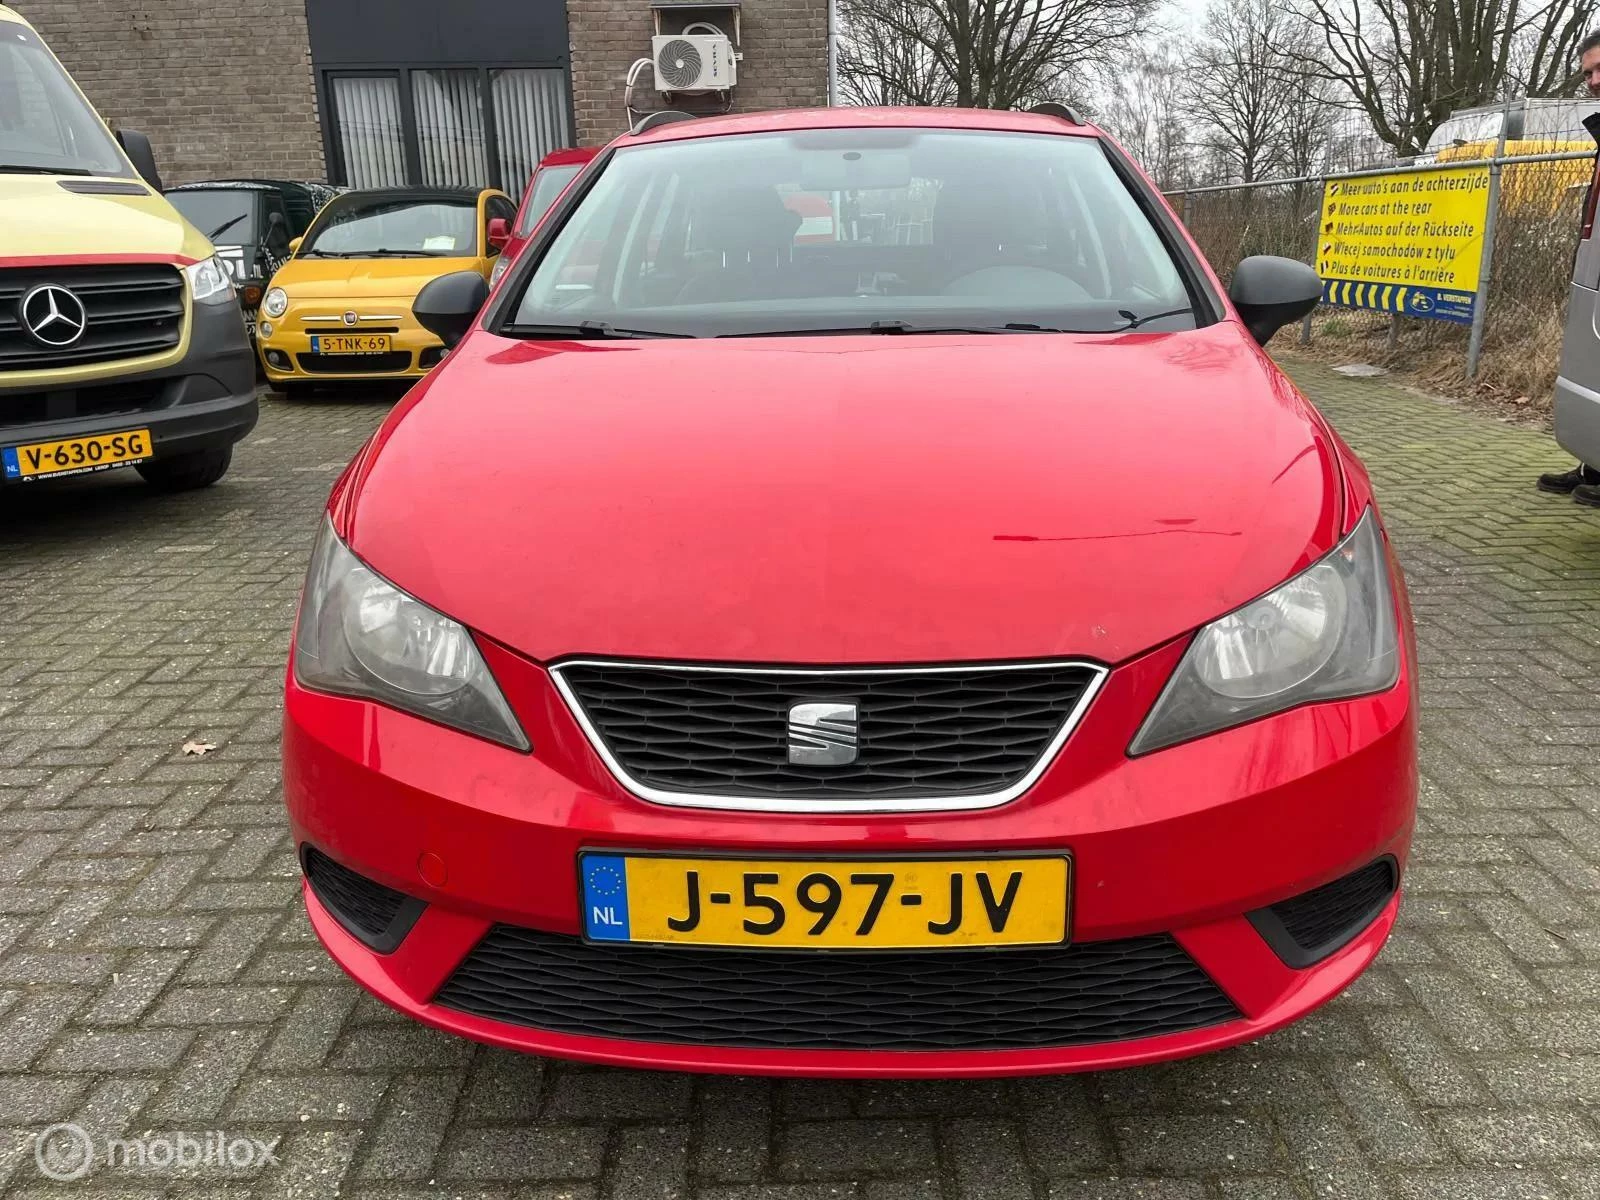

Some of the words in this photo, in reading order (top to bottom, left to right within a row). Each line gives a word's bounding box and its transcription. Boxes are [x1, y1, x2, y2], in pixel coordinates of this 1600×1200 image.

[1341, 182, 1361, 196] Meer
[1363, 180, 1388, 195] auto's
[1390, 180, 1409, 194] aan
[1412, 176, 1424, 192] de
[1426, 172, 1488, 193] achterzijde
[1338, 203, 1359, 216] More
[1361, 203, 1377, 215] cars
[1380, 202, 1391, 215] at
[1392, 200, 1409, 215] the
[1412, 202, 1432, 215] rear
[1386, 221, 1403, 236] auf
[1405, 221, 1421, 236] der
[1423, 221, 1474, 238] Rückseite
[1362, 243, 1424, 259] samochodów
[1426, 249, 1432, 259] z
[1331, 260, 1349, 274] Plus
[1350, 261, 1361, 276] de
[1363, 264, 1401, 279] voitures
[1404, 265, 1411, 280] à
[1412, 265, 1455, 284] l'arrière
[324, 338, 386, 350] 5-TNK-69
[26, 434, 143, 470] V-630-SG
[7, 464, 19, 473] NL
[667, 870, 1023, 936] J-597-JV
[593, 907, 623, 926] NL
